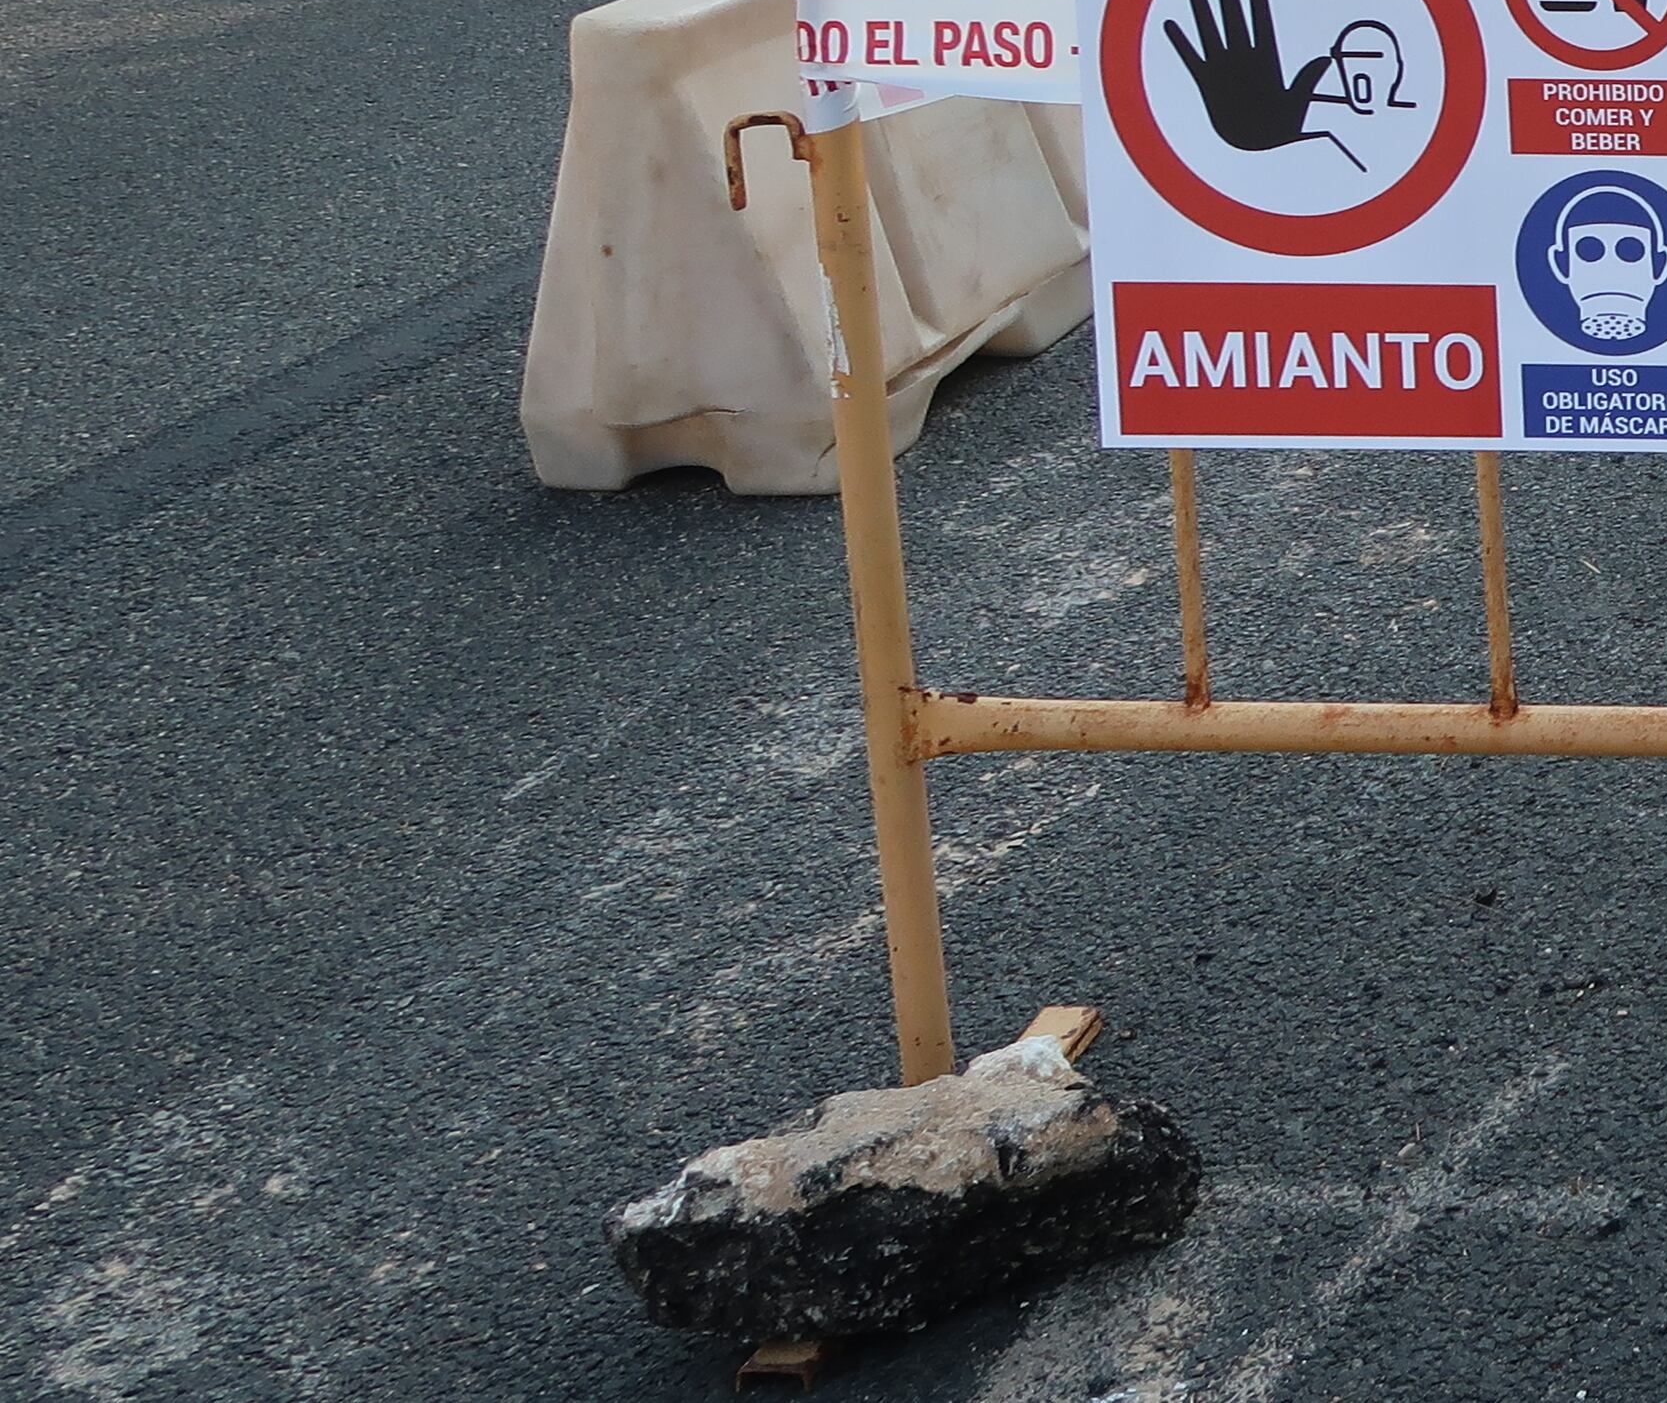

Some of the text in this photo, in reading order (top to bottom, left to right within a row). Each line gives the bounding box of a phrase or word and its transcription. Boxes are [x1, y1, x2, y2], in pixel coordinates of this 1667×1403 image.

[865, 20, 920, 67] EL
[933, 20, 1055, 70] PASO
[1542, 82, 1666, 104] PROHIBIDO
[1555, 107, 1656, 128] COMER Y
[1570, 132, 1643, 152] BEBER
[1129, 330, 1486, 392] AMIANTO
[1591, 368, 1639, 388] USO
[1545, 415, 1575, 436] DE
